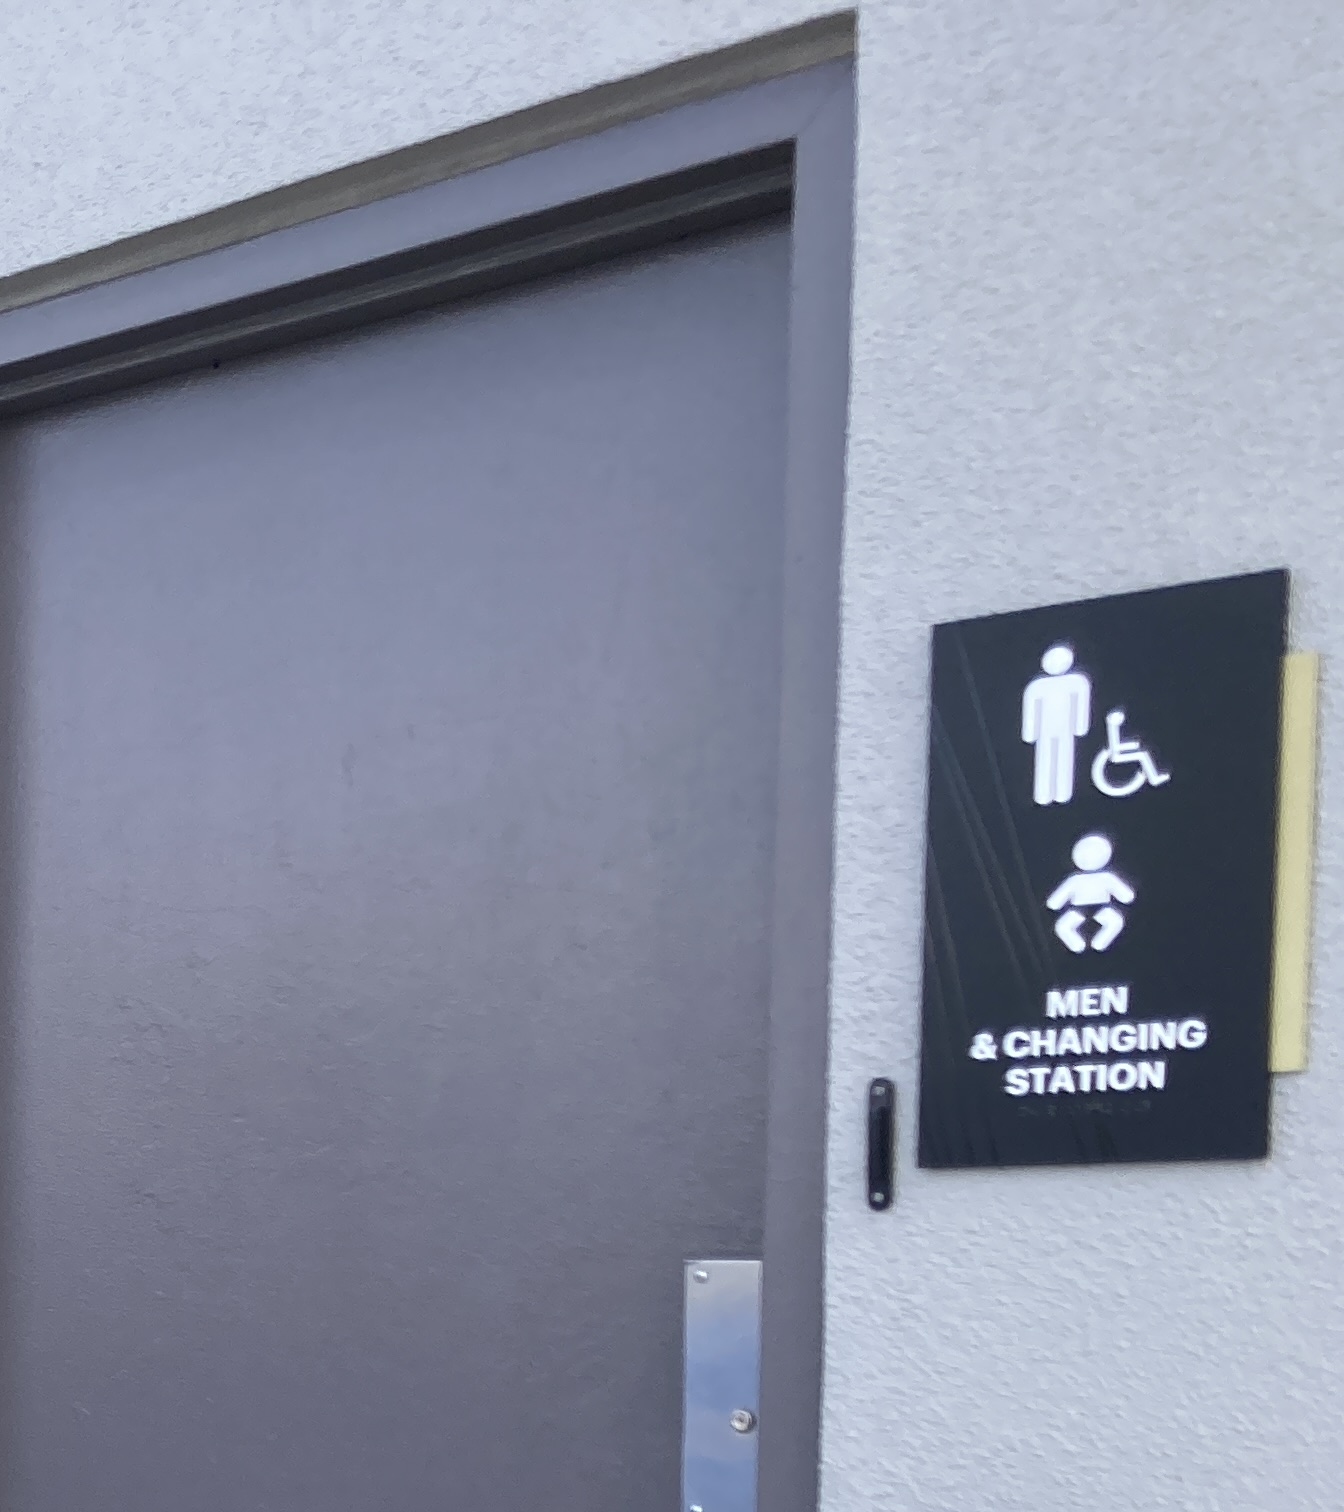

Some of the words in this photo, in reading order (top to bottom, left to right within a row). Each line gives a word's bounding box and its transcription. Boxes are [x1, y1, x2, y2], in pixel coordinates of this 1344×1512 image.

[1045, 985, 1129, 1019] MEN
[968, 1032, 997, 1061] &
[1002, 1019, 1208, 1059] CHANGING
[1003, 1061, 1166, 1097] STATION
